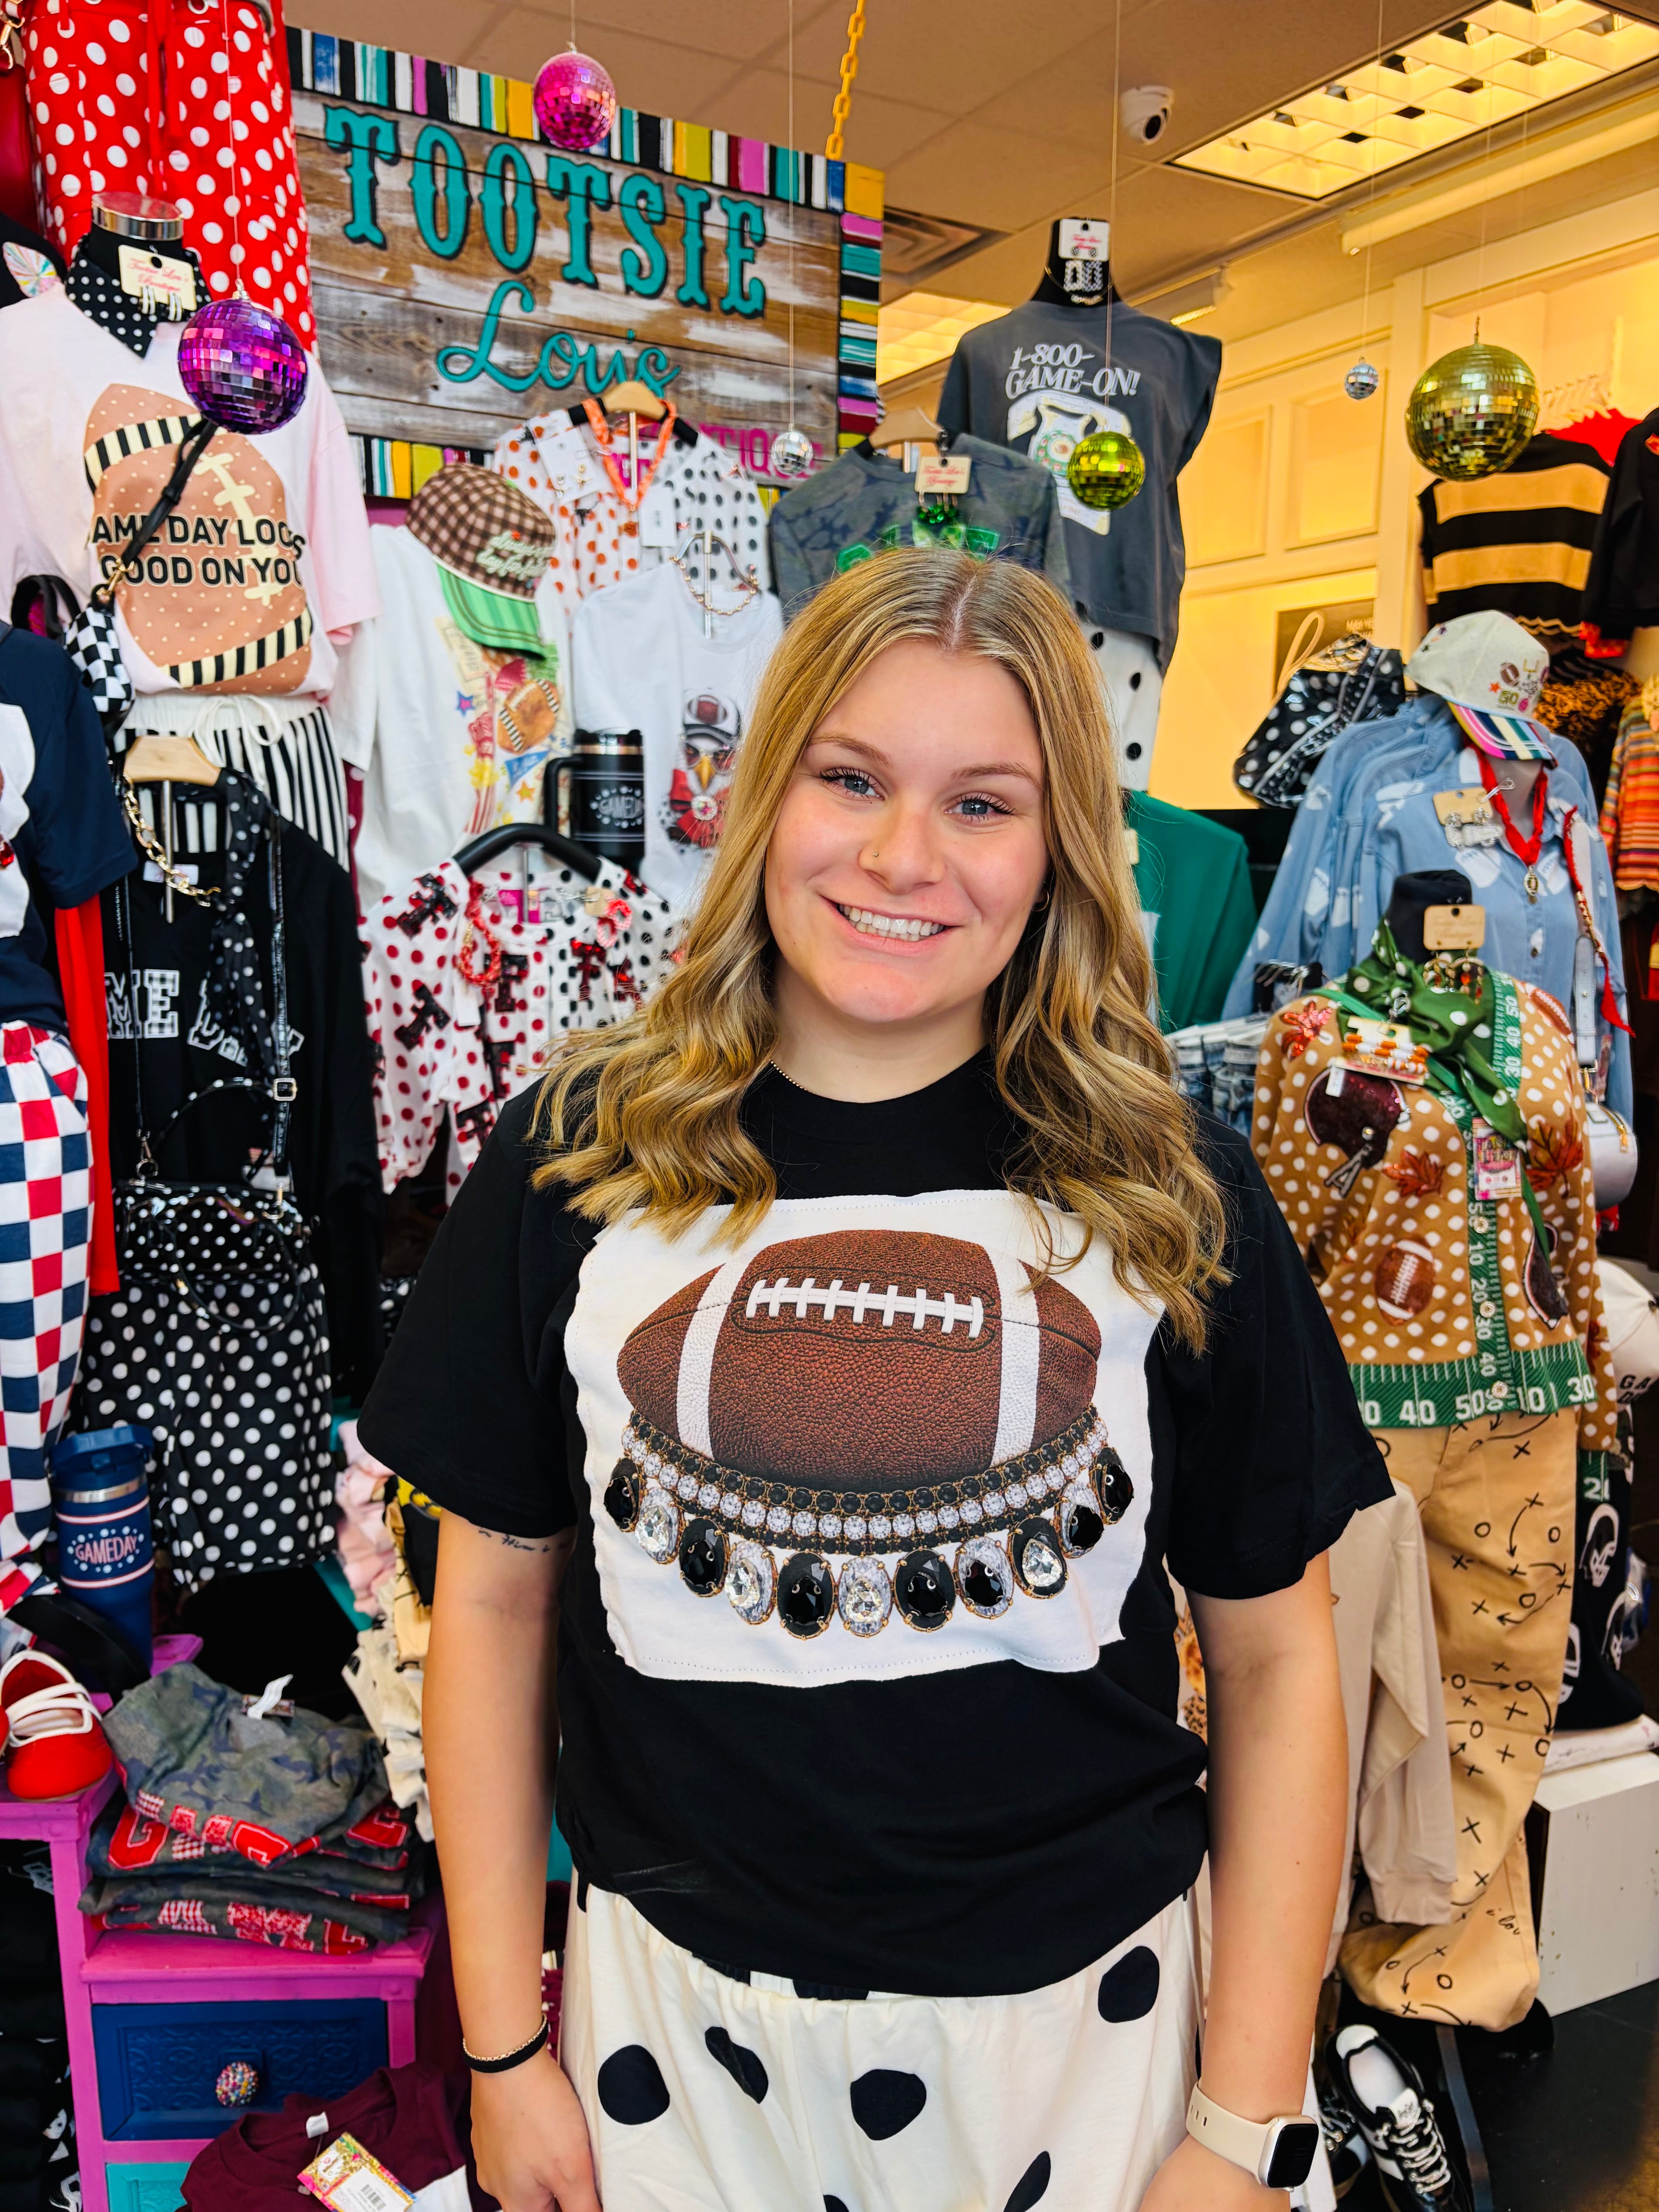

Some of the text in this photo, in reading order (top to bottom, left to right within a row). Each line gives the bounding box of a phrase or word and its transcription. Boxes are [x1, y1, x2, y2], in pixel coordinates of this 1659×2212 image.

[324, 104, 767, 317] TOOTSIE
[1009, 343, 1095, 369] 1-800-
[1005, 365, 1141, 400] GAME-ON!
[167, 515, 228, 545] DAY
[101, 555, 192, 584] GOOD
[202, 557, 245, 584] ON
[1399, 1399, 1437, 1426] 40
[1455, 1389, 1486, 1420] 50
[1567, 1374, 1595, 1403] 30
[75, 1535, 137, 1564] GAMEDAY
